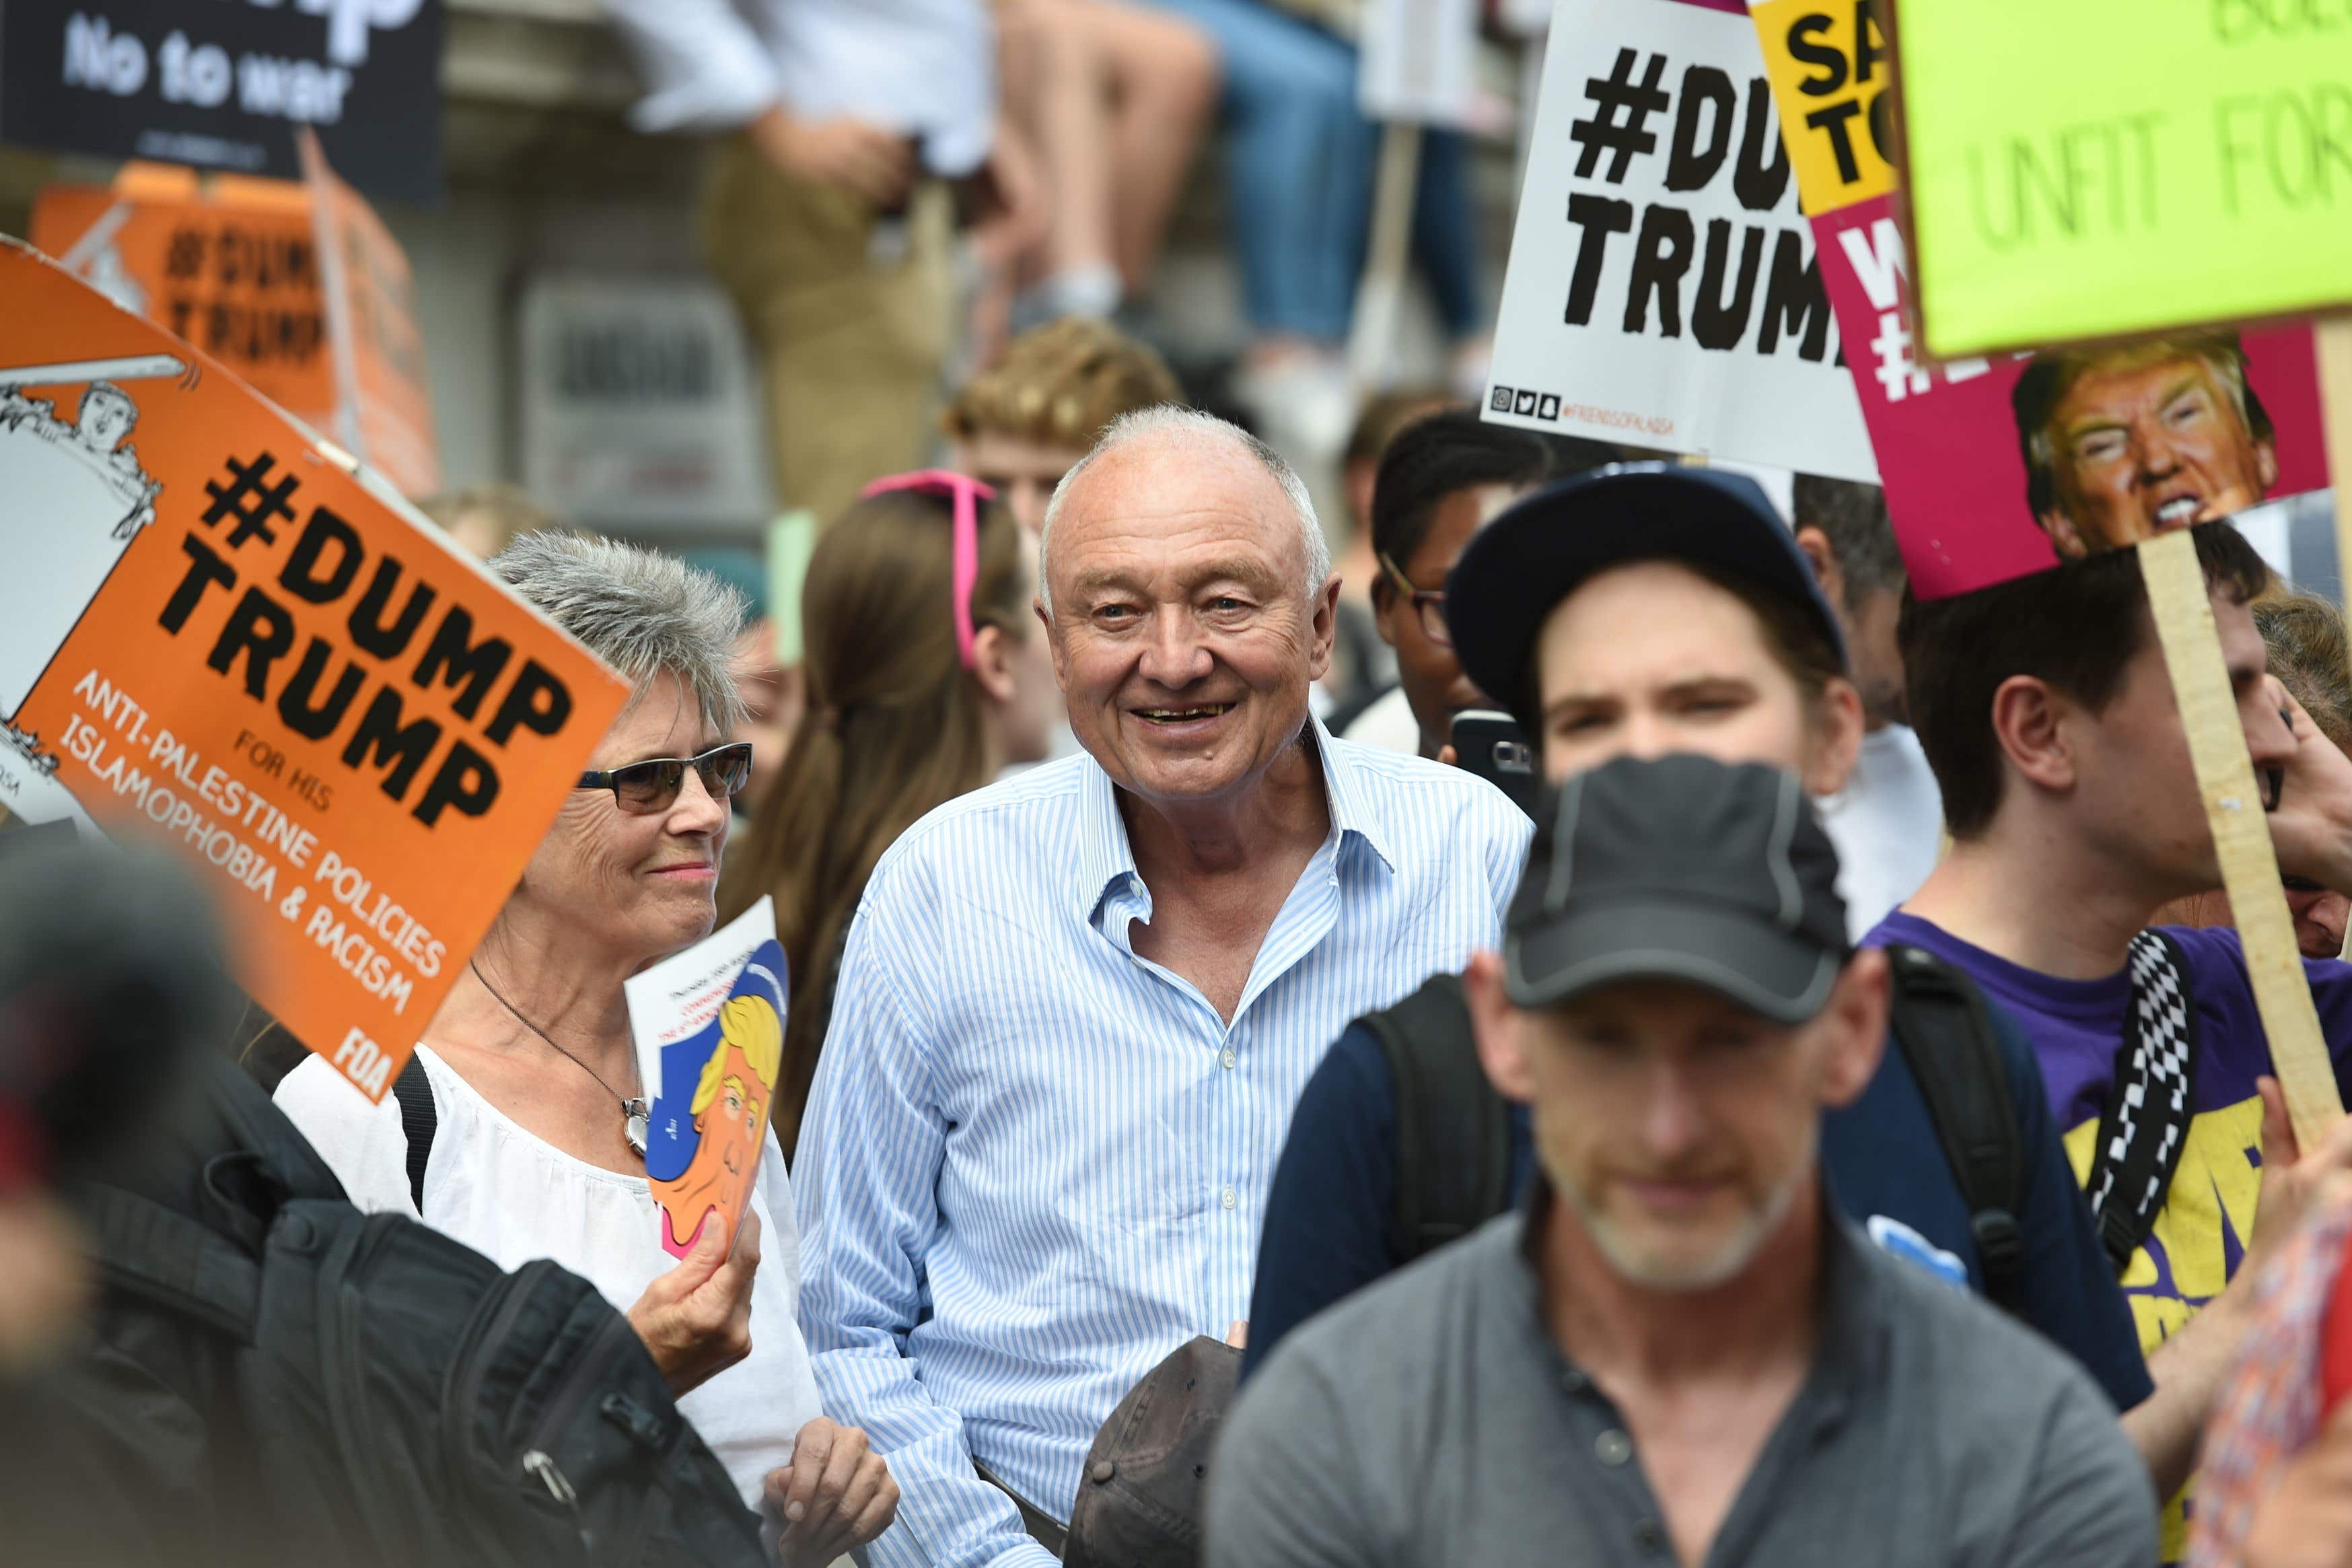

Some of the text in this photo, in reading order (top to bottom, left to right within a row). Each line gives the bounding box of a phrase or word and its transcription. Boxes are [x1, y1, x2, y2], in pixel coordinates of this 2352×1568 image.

[63, 11, 149, 96] No
[157, 30, 233, 108] to
[236, 52, 354, 124] war
[1965, 82, 2352, 256] UNFIT FOR
[1565, 192, 1848, 368] TRUM
[158, 532, 500, 828] TRUMP
[201, 452, 573, 748] #DUMP
[73, 669, 448, 978] ANTI-PALESTINE POLICIES
[234, 728, 334, 813] FOR HIS
[61, 713, 414, 1016] ISLAMOPHOBIA & RACISM
[334, 1026, 393, 1098] FOA
